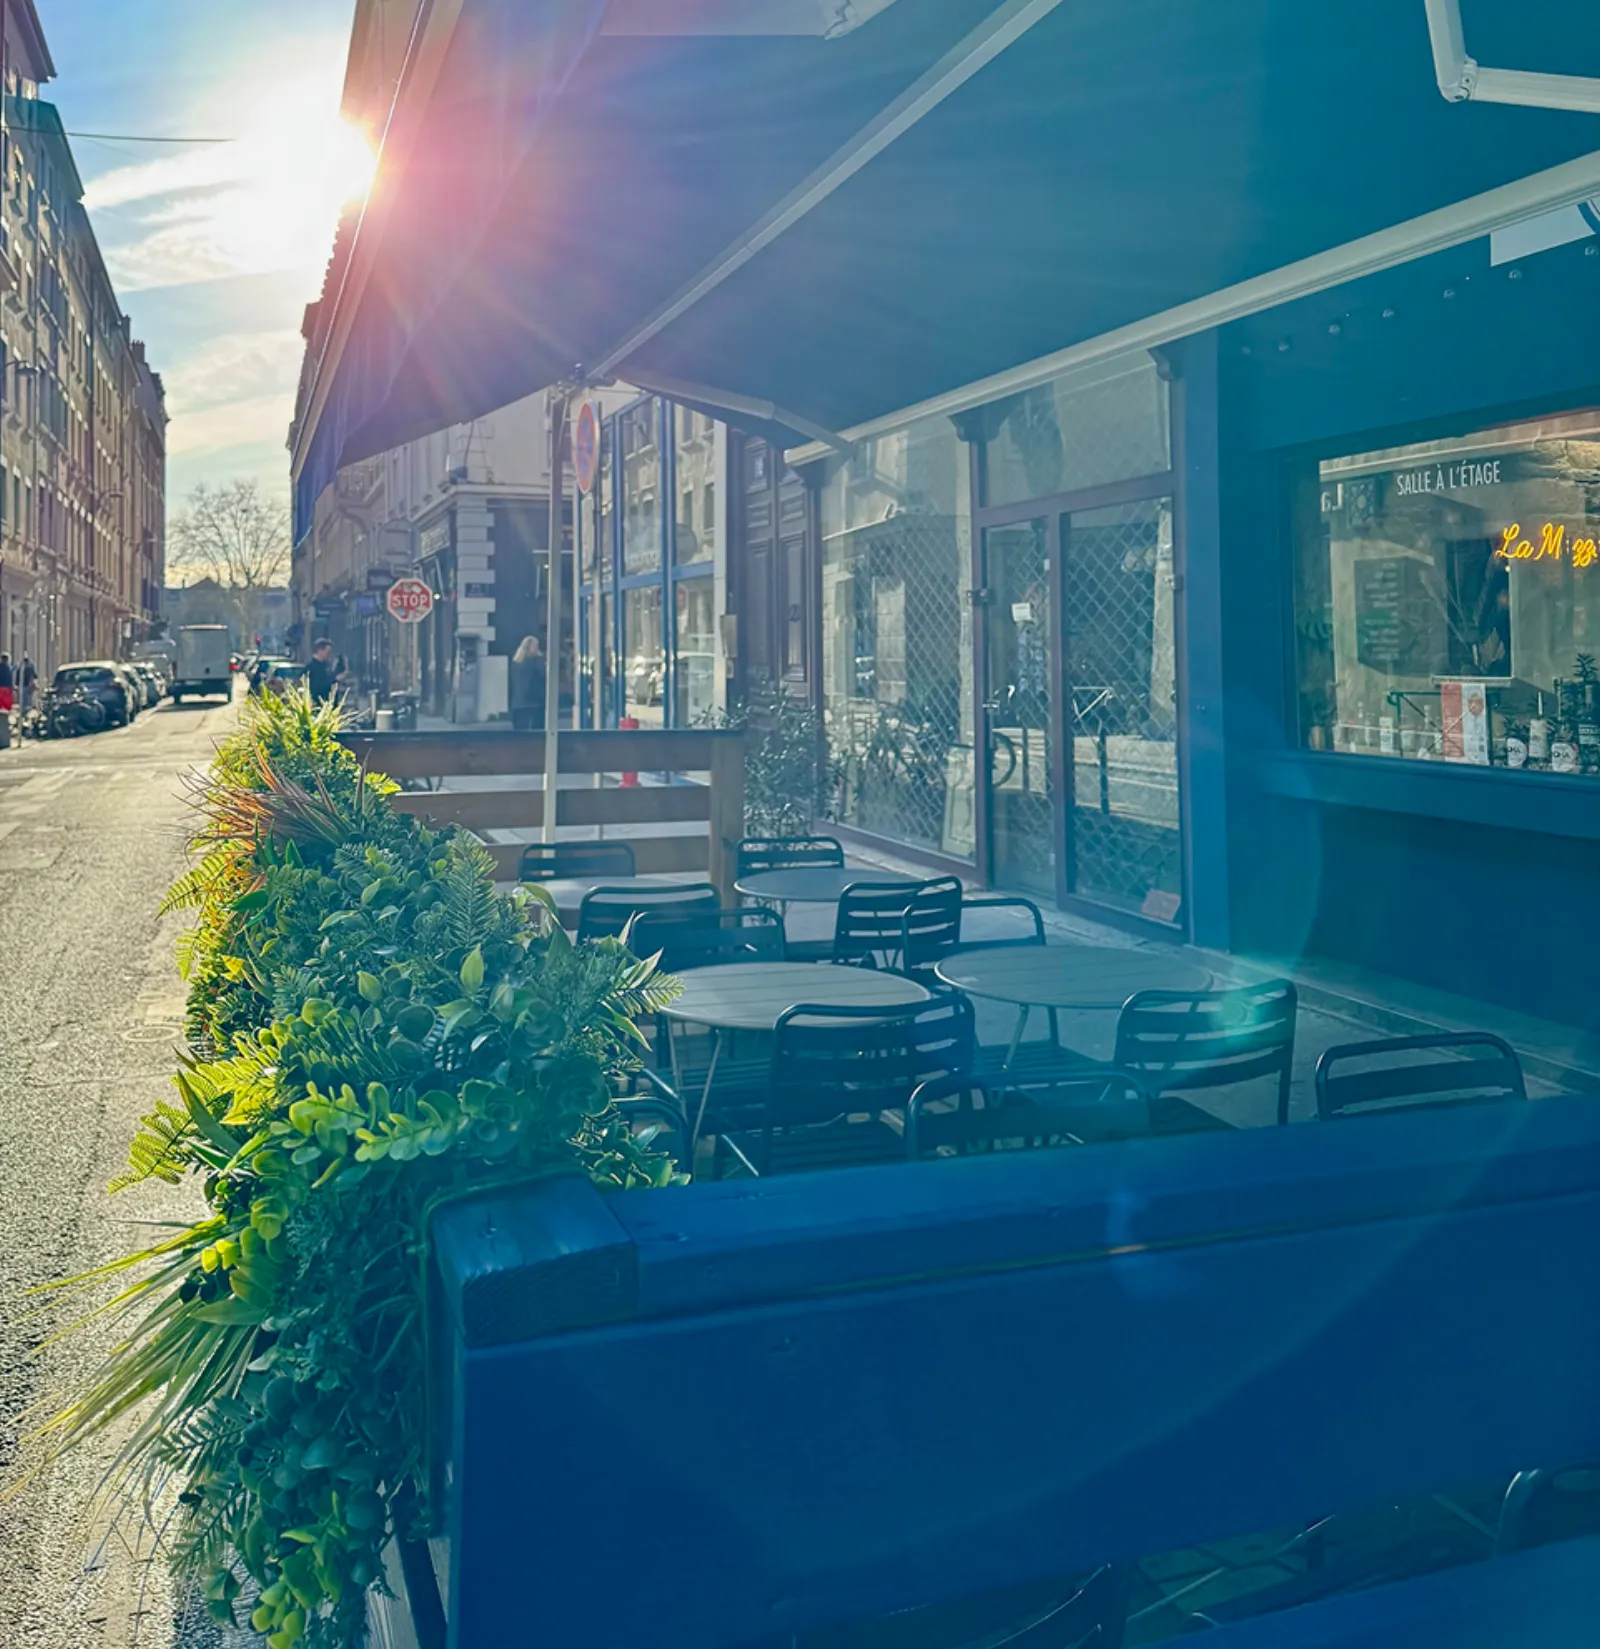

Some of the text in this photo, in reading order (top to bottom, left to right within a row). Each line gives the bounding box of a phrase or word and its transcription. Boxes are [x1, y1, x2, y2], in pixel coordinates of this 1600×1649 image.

[1397, 471, 1431, 495] SALLE
[1435, 464, 1445, 490] À
[1495, 523, 1534, 558] La
[392, 594, 428, 607] STOP
